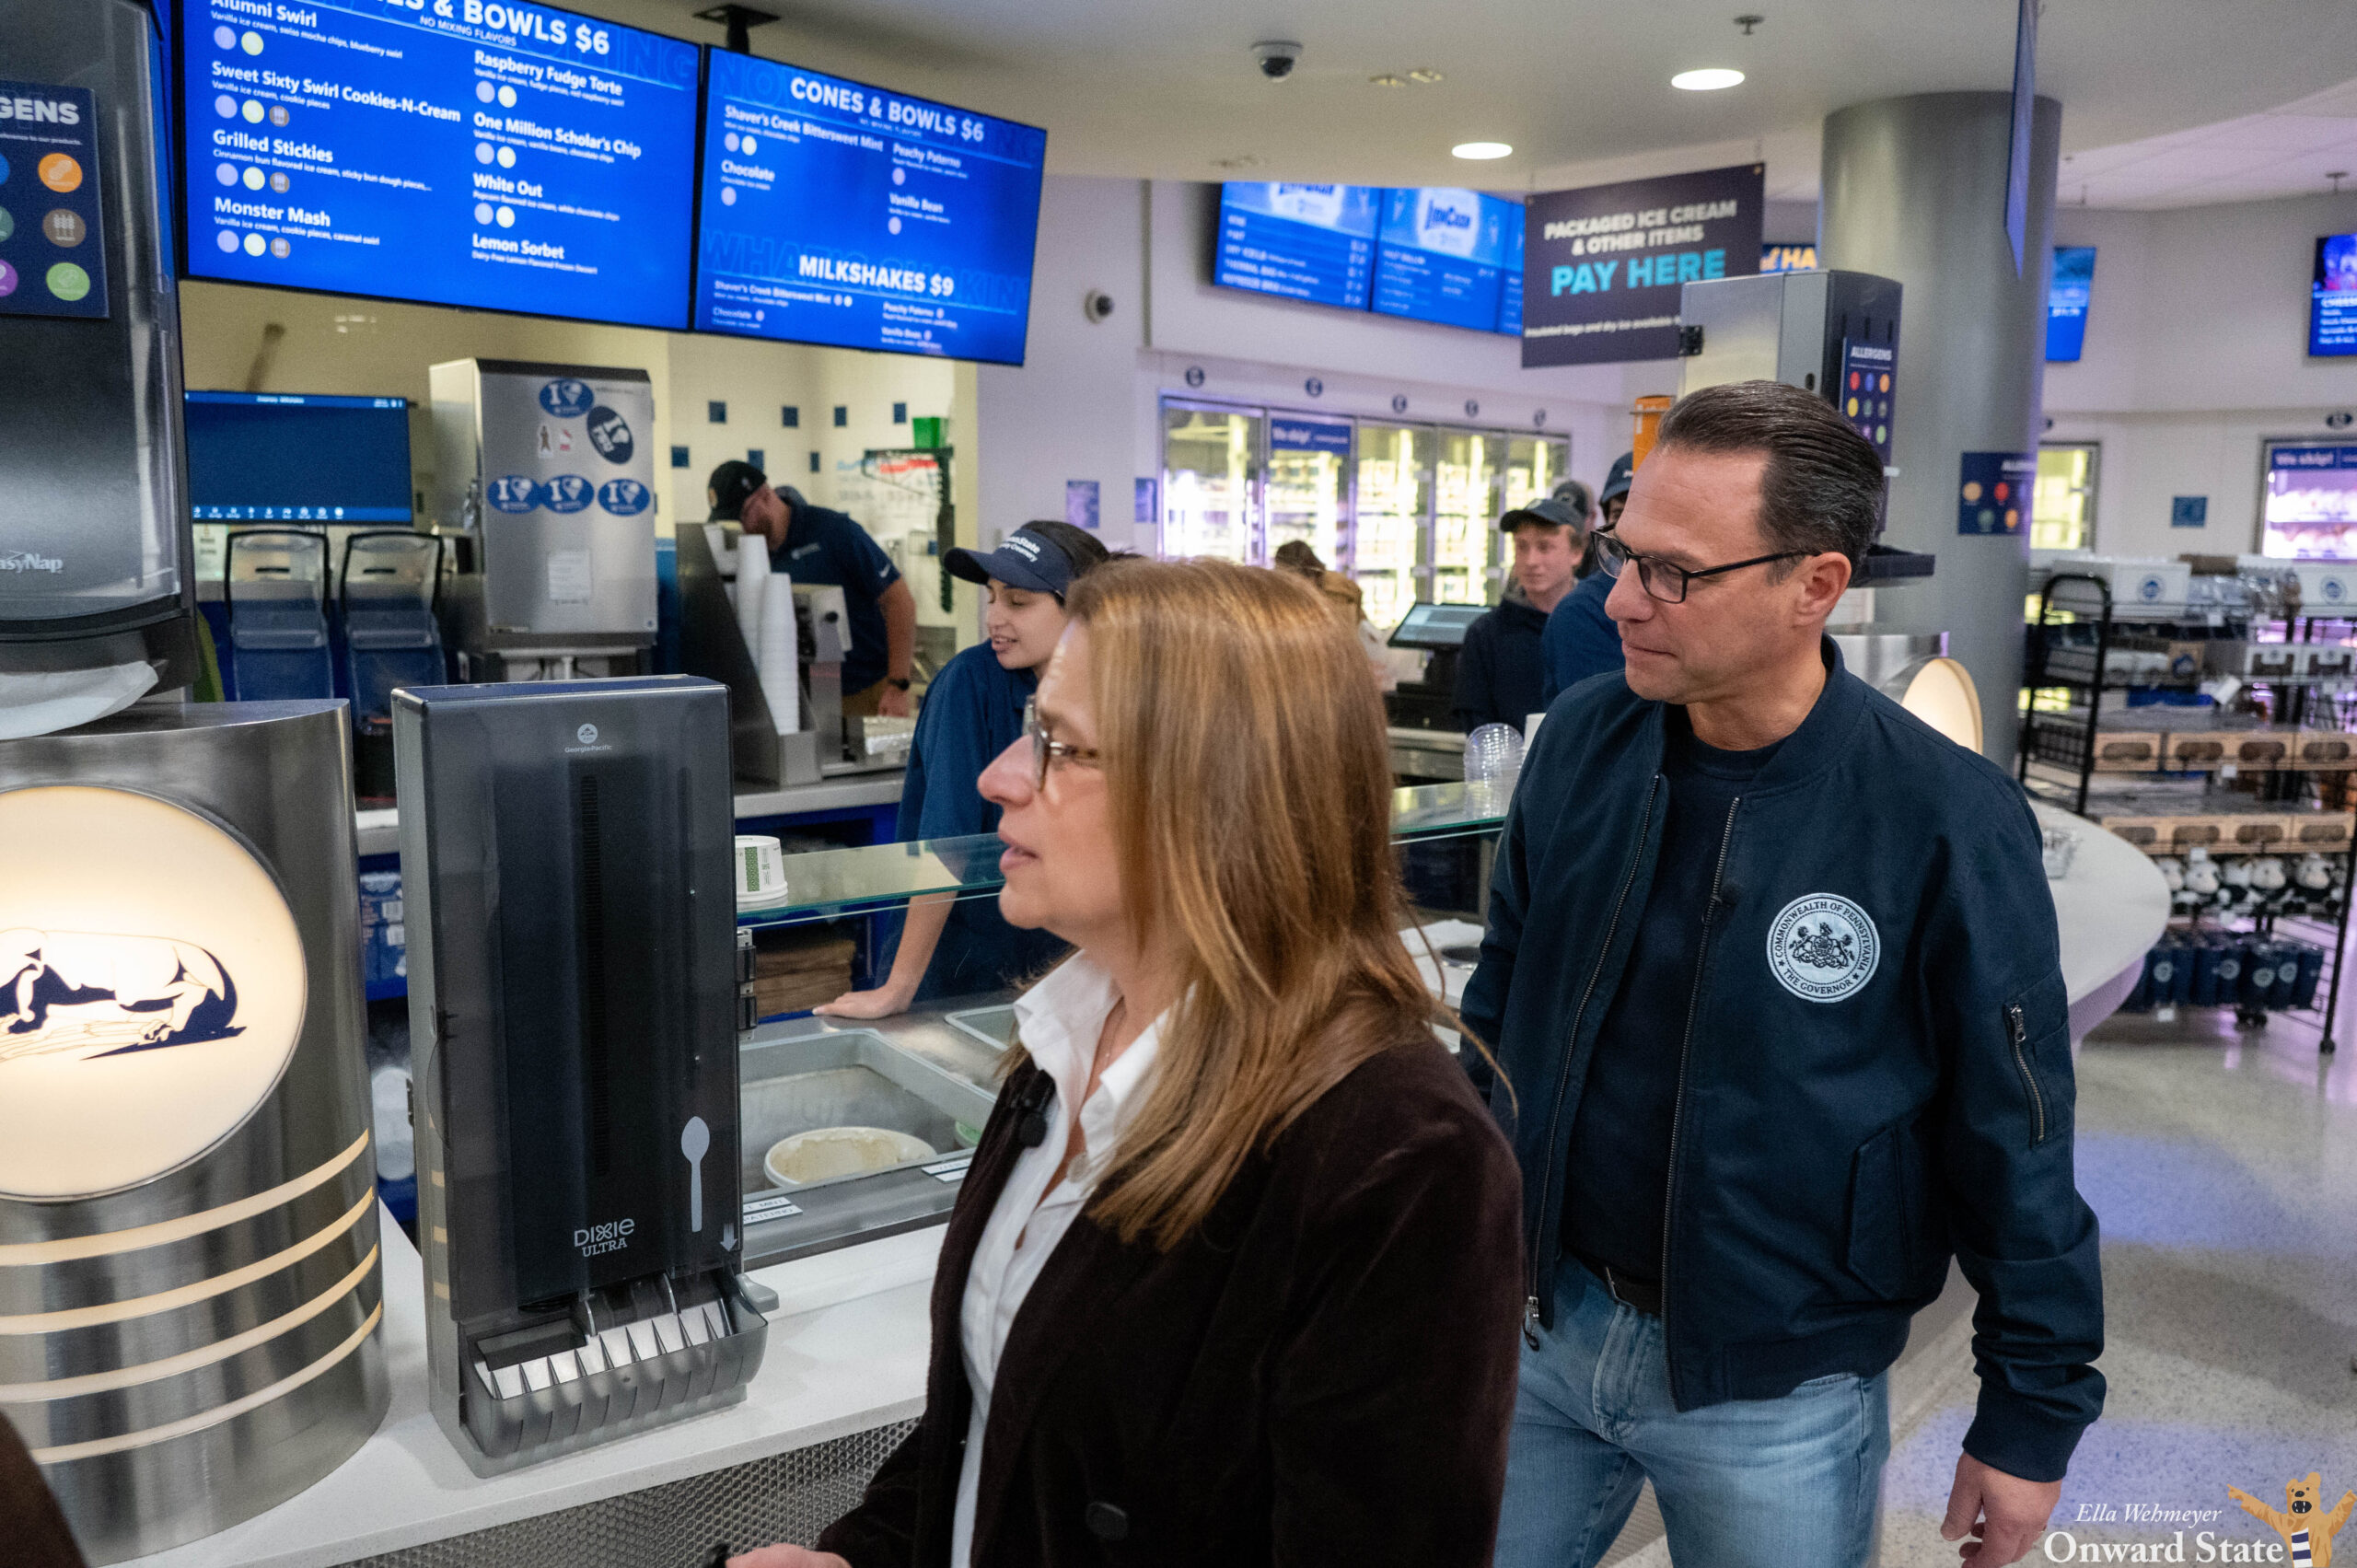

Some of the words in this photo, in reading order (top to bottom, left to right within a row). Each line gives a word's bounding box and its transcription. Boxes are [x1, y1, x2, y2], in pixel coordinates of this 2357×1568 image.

[211, 10, 238, 24] Vanilla
[239, 17, 250, 26] ice
[276, 6, 317, 28] Swirl
[420, 16, 435, 28] NO
[437, 17, 472, 37] MIXING
[474, 29, 517, 47] FLAVORS
[434, 0, 453, 18] &
[464, 0, 567, 45] BOWLS
[575, 23, 610, 55] $6
[212, 80, 238, 93] Vanilla
[240, 84, 251, 94] ice
[474, 49, 544, 81] Raspberry
[547, 65, 586, 89] Fudge
[589, 75, 622, 96] Torte
[212, 61, 259, 83] Sweet
[262, 70, 299, 93] Sixty
[303, 78, 339, 99] Swirl
[343, 87, 460, 122] Cookies-N-Cream
[791, 76, 864, 113] CONES
[869, 96, 882, 118] &
[888, 100, 956, 135] BOWLS
[961, 118, 984, 142] $6
[473, 110, 503, 131] One
[505, 117, 552, 140] Million
[554, 127, 610, 151] Scholar's
[613, 139, 642, 160] Chip
[725, 104, 770, 126] Shaver's
[771, 115, 801, 134] Creek
[860, 135, 884, 152] Mint
[213, 129, 269, 152] Grilled
[273, 138, 333, 163] Stickies
[473, 172, 515, 193] White
[517, 180, 542, 198] Out
[721, 159, 775, 181] Chocolate
[215, 197, 284, 219] Monster
[288, 207, 331, 227] Mash
[1544, 212, 1634, 240] PACKAGED
[1637, 207, 1667, 230] ICE
[1669, 200, 1737, 224] CREAM
[472, 233, 518, 252] Lemon
[520, 239, 564, 260] Sorbet
[1571, 239, 1585, 256] &
[1587, 231, 1645, 254] OTHER
[1647, 225, 1704, 247] ITEMS
[799, 254, 926, 293] MILKSHAKES
[930, 273, 954, 296] $9
[1551, 261, 1619, 296] PAY
[1627, 249, 1725, 288] HERE
[1775, 901, 1828, 958] COMMONWEALTH
[1829, 902, 1843, 912] OF
[1844, 907, 1871, 971] PENNSYLVANIA
[1783, 968, 1799, 986] THE
[1800, 979, 1853, 994] GOVERNOR
[582, 1237, 628, 1258] ULTRA
